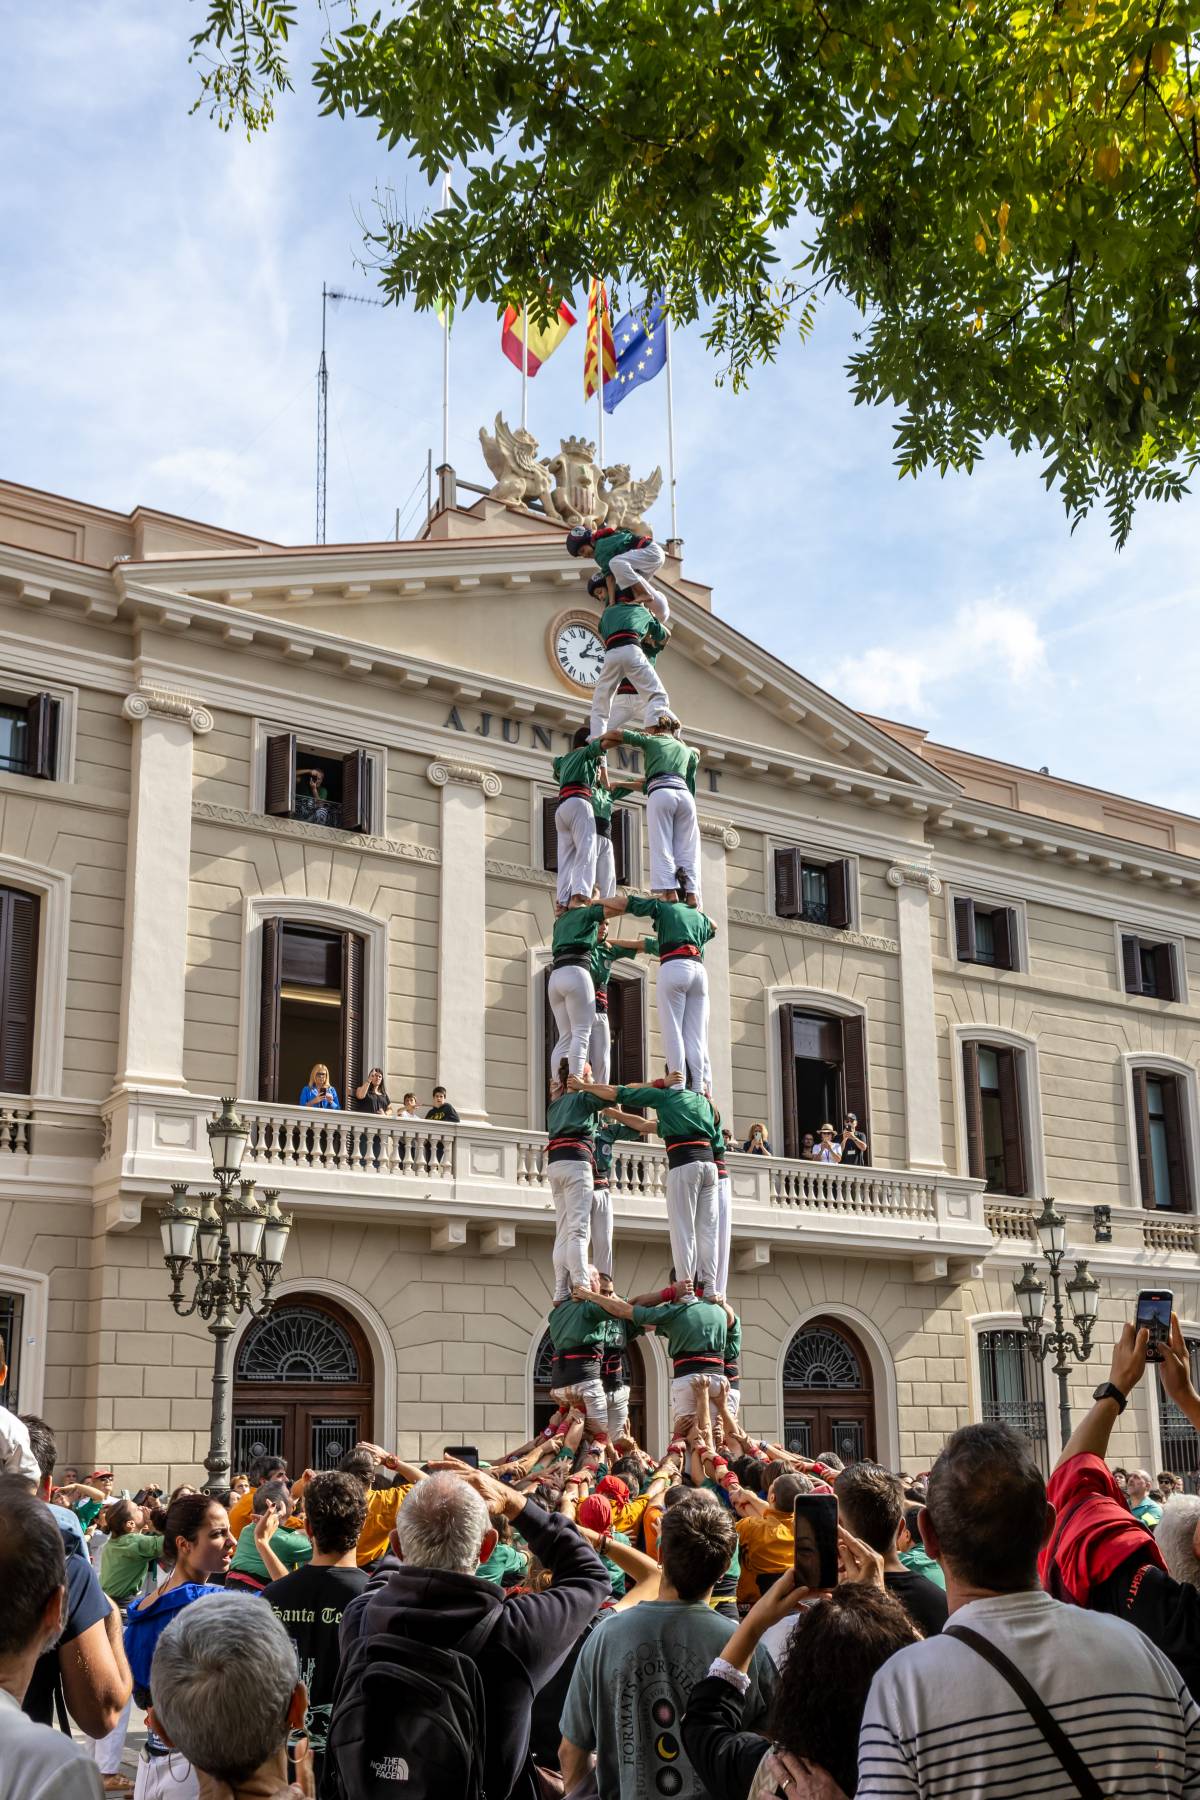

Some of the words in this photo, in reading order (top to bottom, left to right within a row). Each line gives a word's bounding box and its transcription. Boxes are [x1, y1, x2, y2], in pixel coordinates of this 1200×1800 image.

[442, 705, 723, 793] AJUNTMT
[272, 1606, 315, 1623] Santa
[621, 1681, 638, 1767] FORMATS
[634, 1660, 667, 1682] FOR
[370, 1760, 398, 1773] NORTH
[384, 1756, 399, 1765] THE
[375, 1770, 398, 1780] FACE
